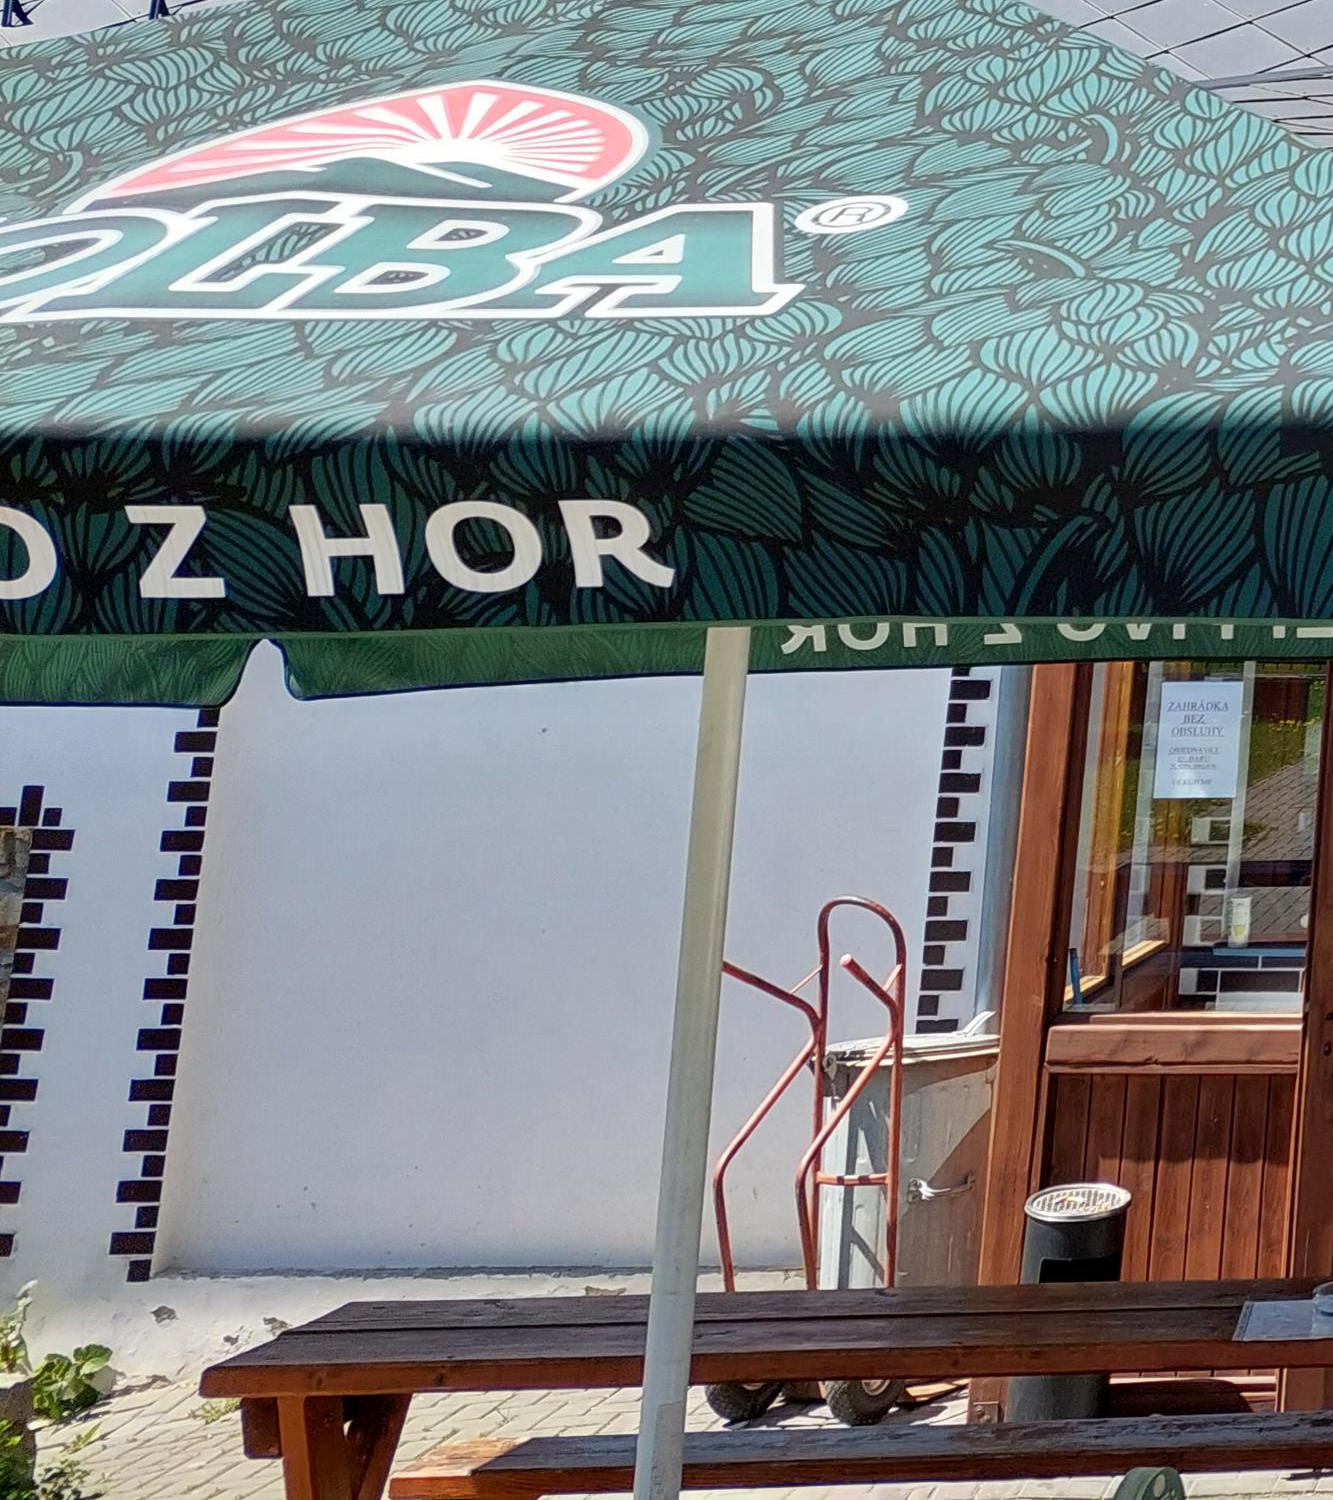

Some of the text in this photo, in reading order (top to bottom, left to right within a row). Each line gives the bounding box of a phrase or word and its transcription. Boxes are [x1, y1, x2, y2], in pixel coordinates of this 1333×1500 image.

[125, 504, 227, 599] Z
[289, 500, 676, 598] HOR
[1167, 700, 1230, 712] ZAHRÁDKA
[1182, 713, 1207, 724] BEZ
